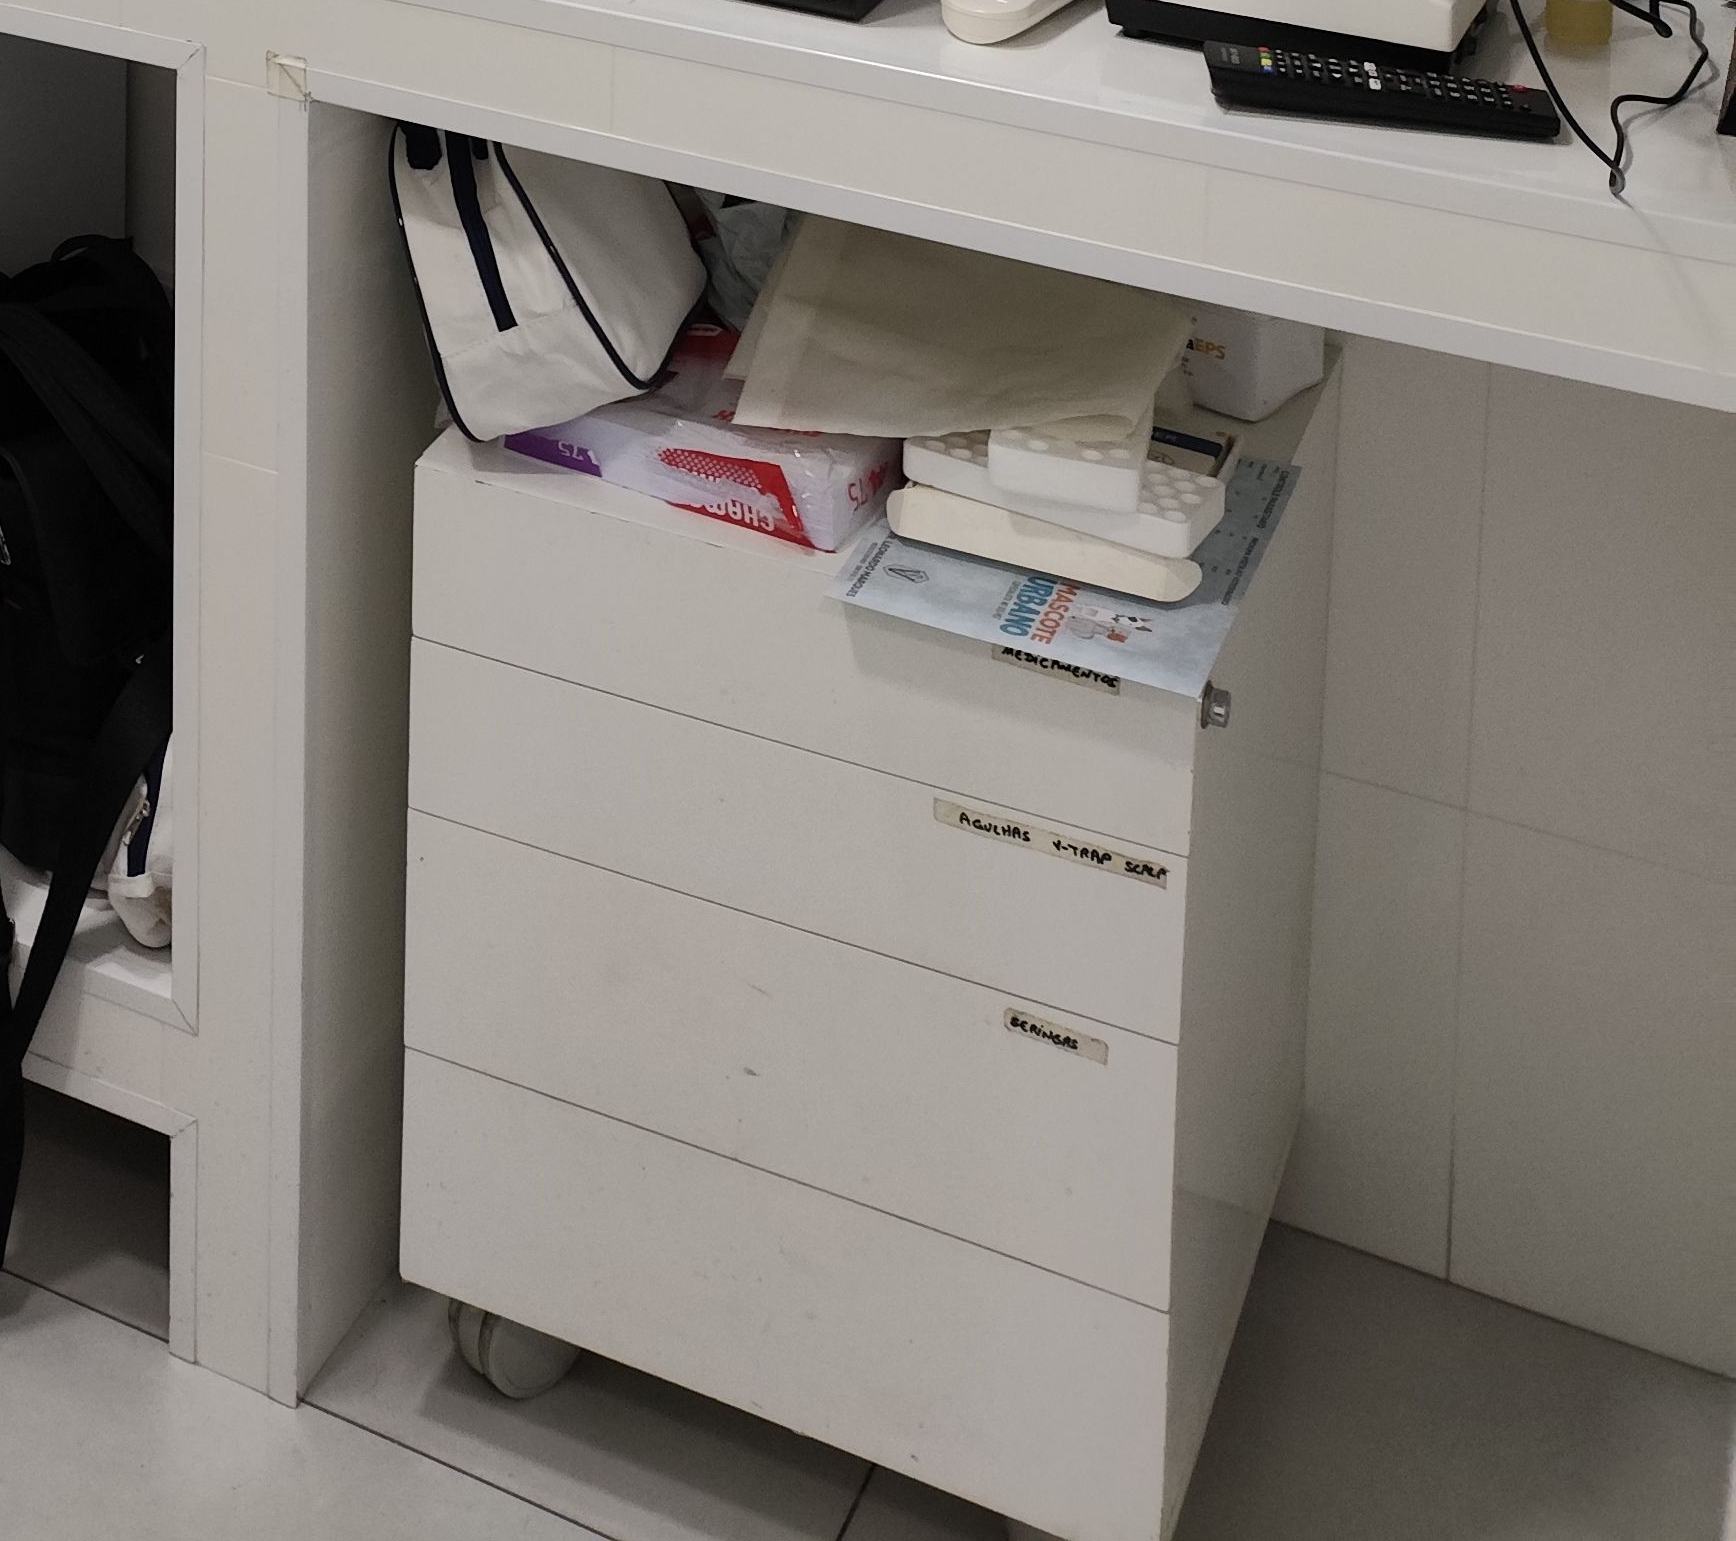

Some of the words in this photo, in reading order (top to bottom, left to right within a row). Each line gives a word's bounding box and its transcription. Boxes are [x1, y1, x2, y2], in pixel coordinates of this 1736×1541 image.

[999, 576, 1046, 638] URBANO
[1030, 580, 1081, 645] MASCOTE
[959, 812, 1031, 842] AGULHAS
